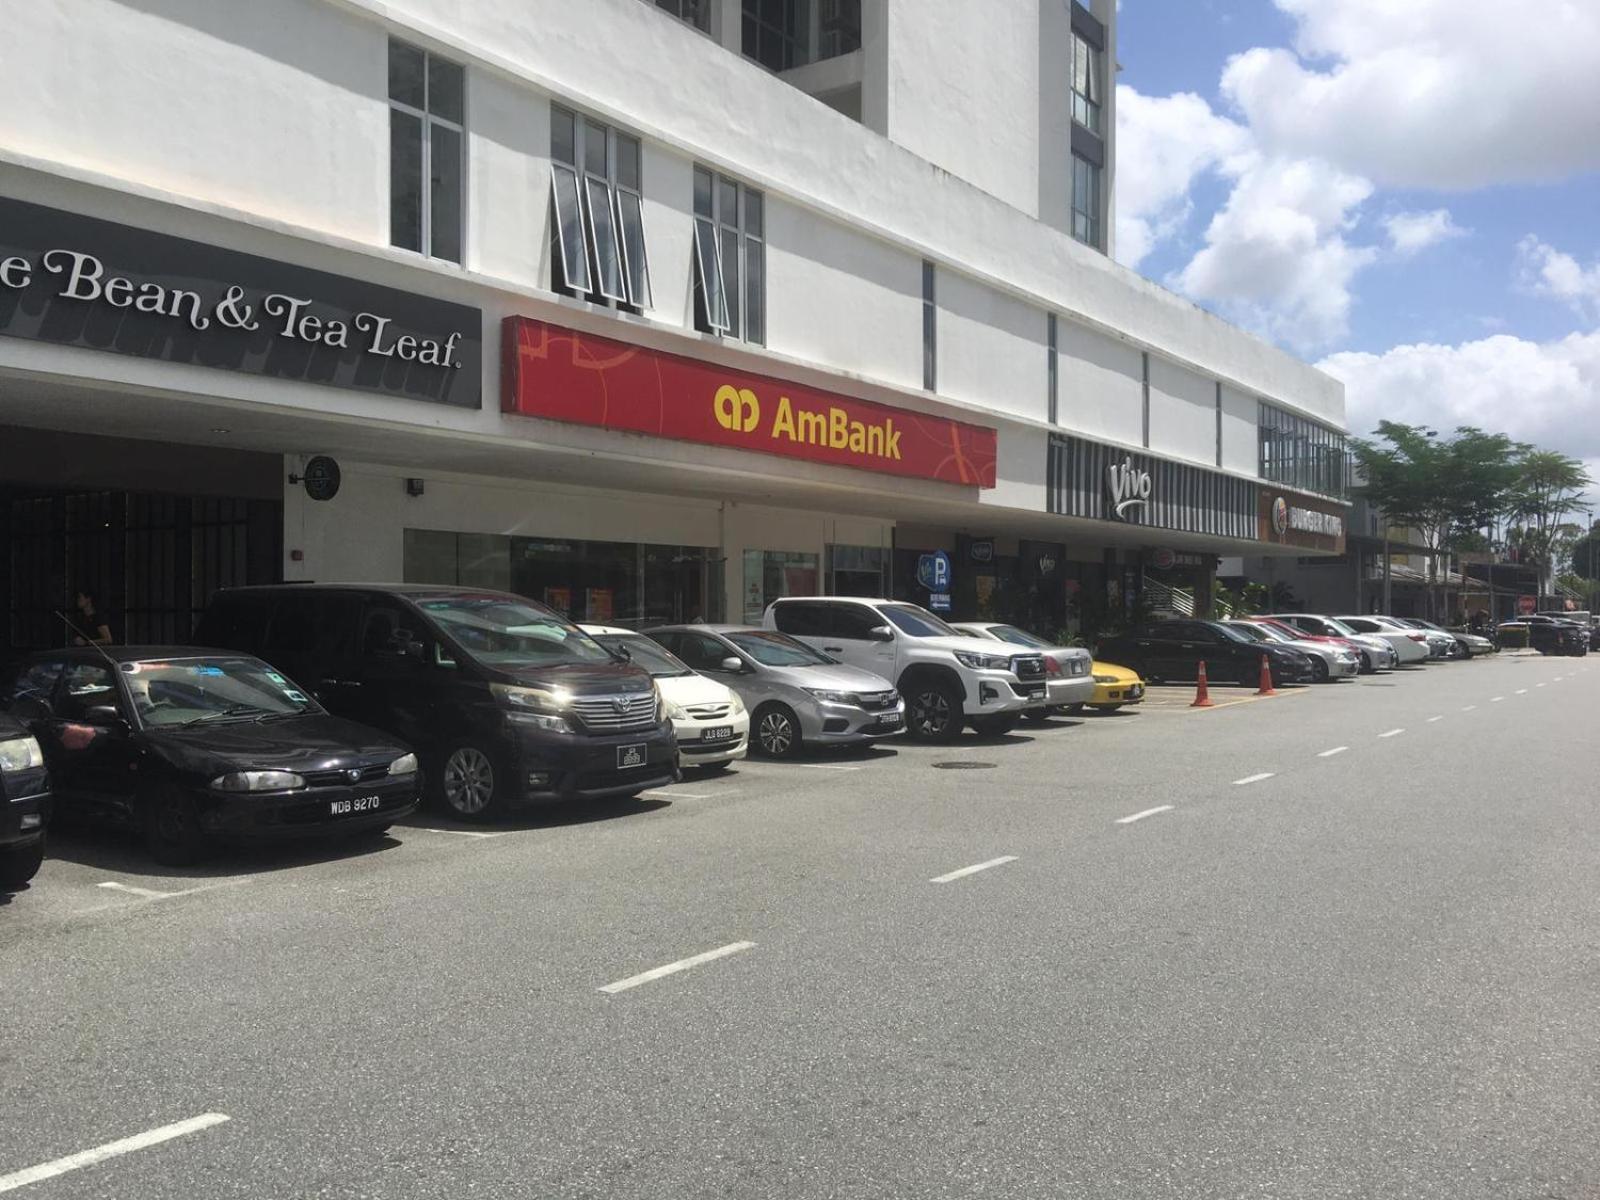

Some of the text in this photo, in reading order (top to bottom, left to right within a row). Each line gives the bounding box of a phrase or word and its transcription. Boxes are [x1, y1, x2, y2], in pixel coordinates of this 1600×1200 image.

[43, 249, 209, 330] Bean
[215, 285, 259, 331] &
[264, 293, 348, 348] Tea
[771, 396, 902, 460] AmBank
[1290, 506, 1323, 533] BURGER
[331, 795, 380, 815] WDB 9270
